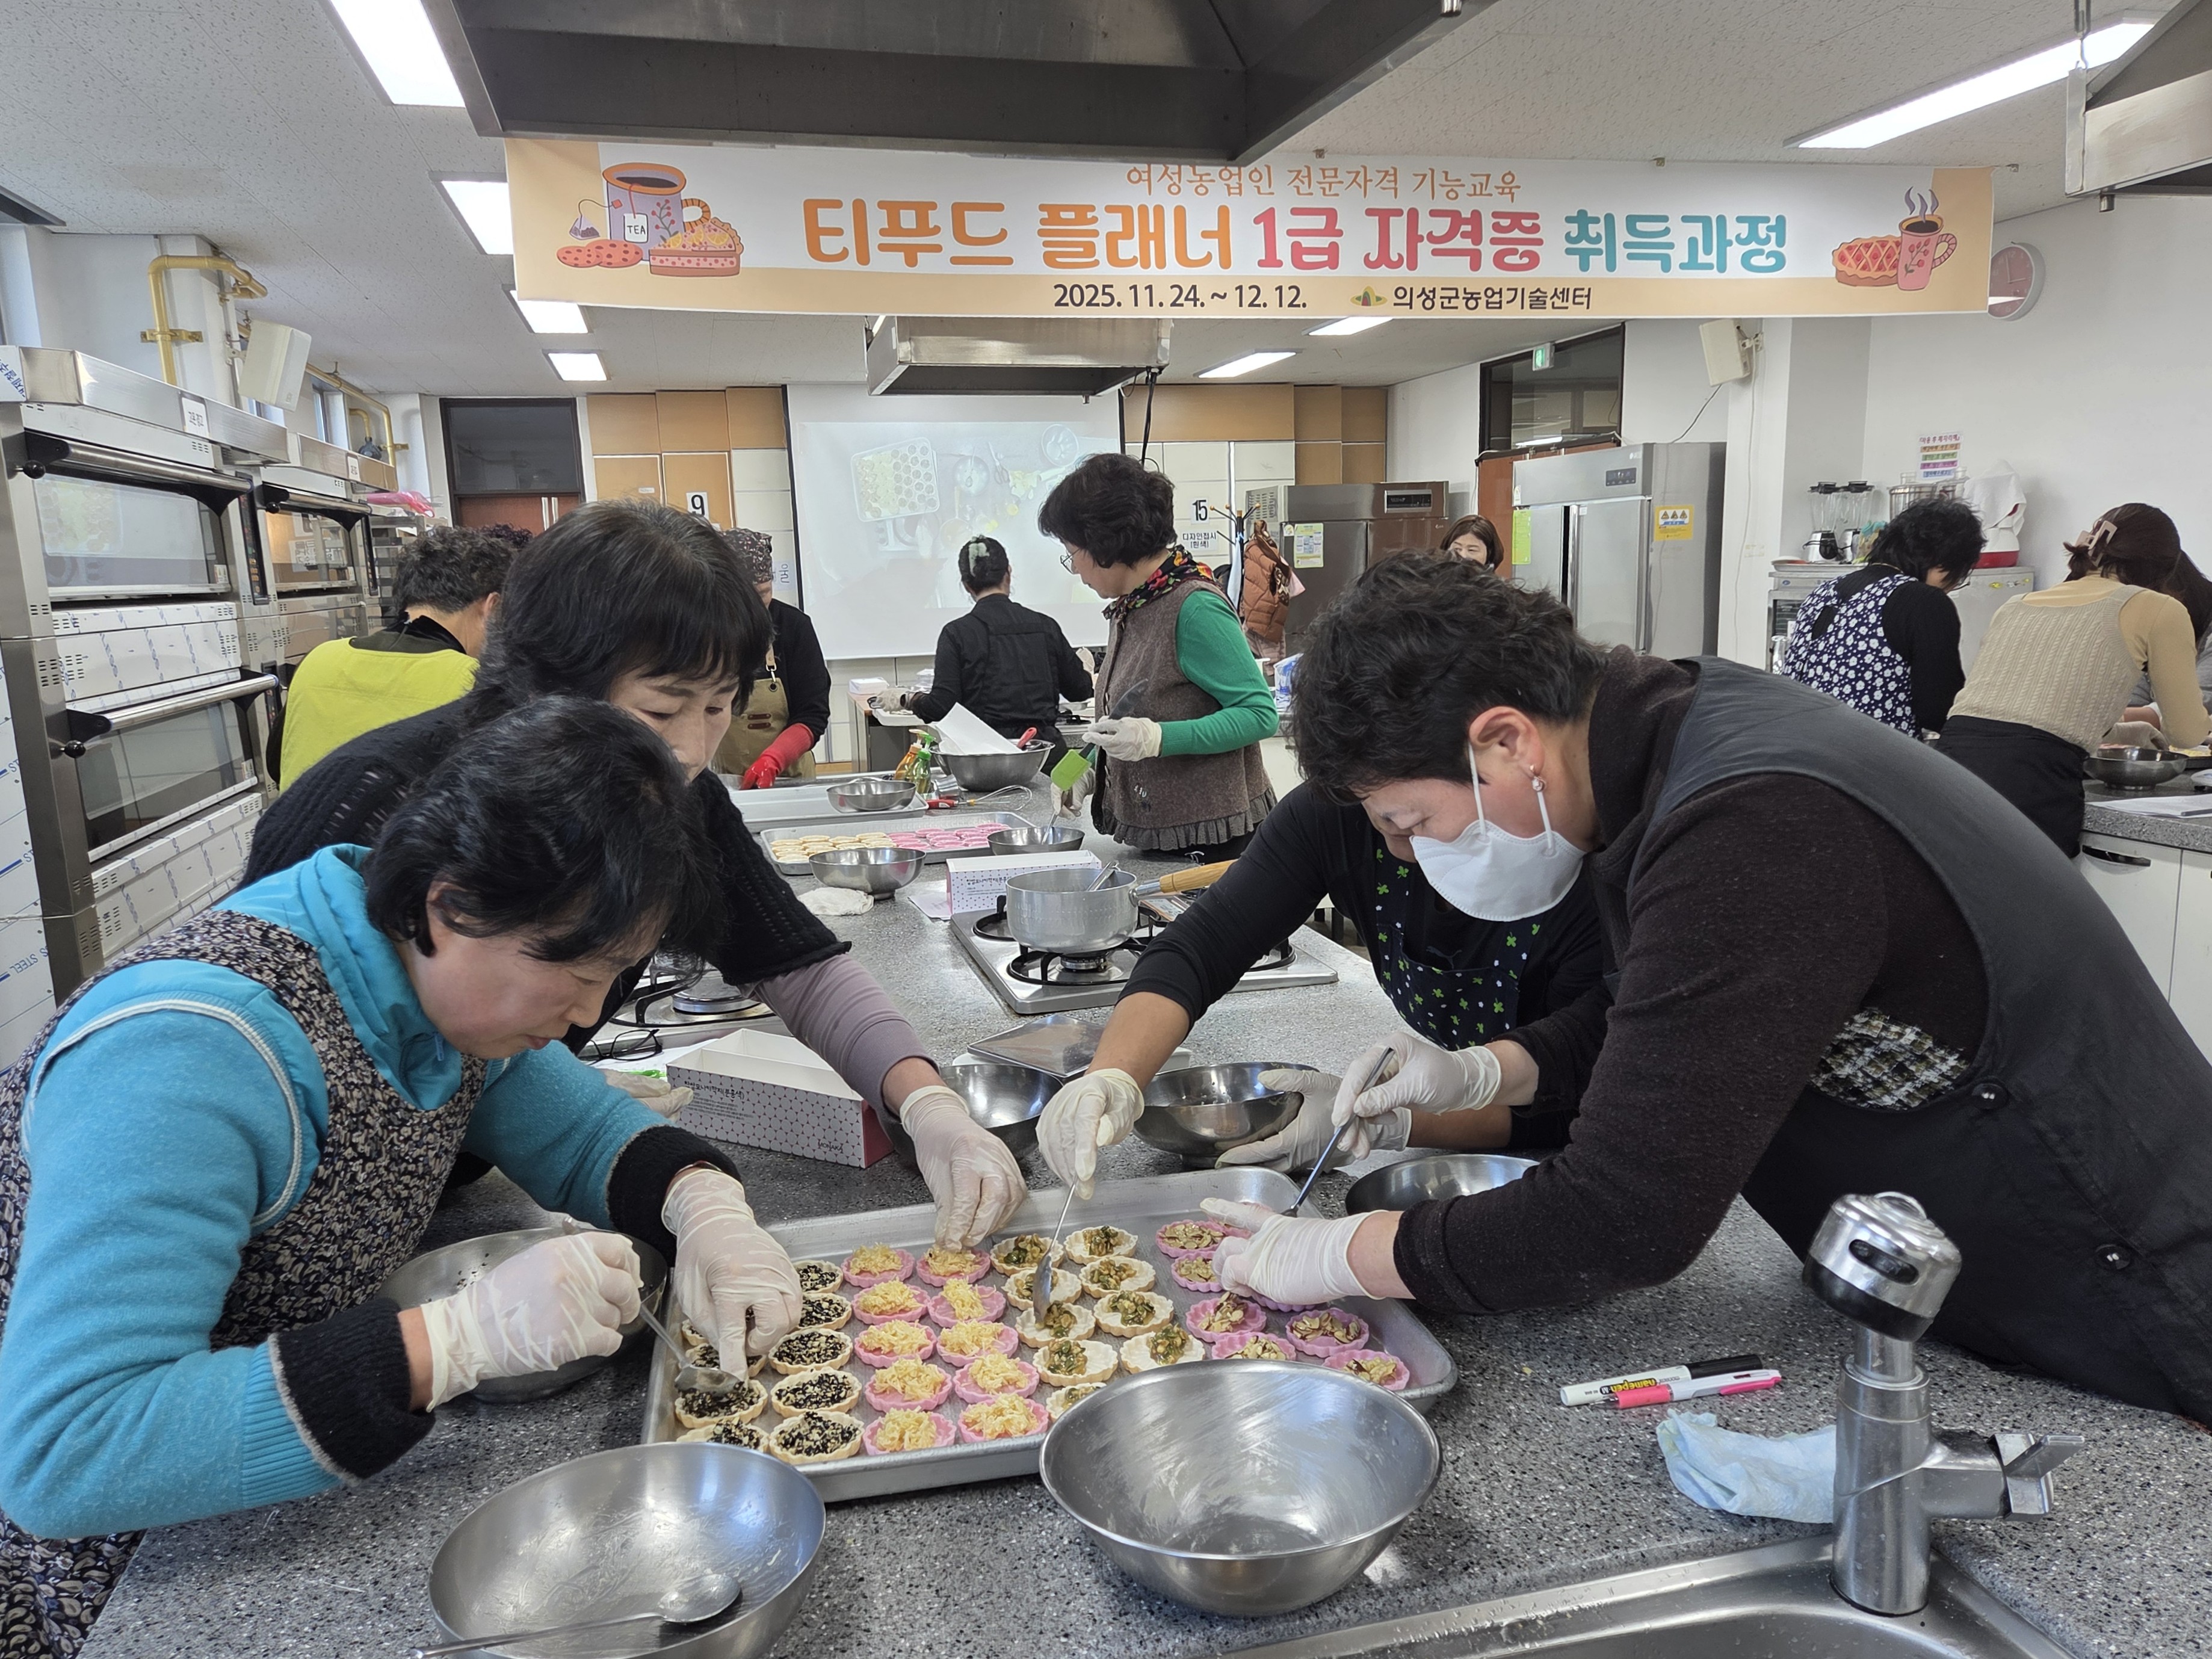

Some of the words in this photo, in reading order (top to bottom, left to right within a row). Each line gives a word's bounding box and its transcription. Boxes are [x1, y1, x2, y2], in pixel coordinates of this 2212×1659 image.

[1126, 164, 1274, 197] 여성농업인
[1287, 164, 1400, 200] 전문자격
[1412, 167, 1522, 203] 기능교육
[626, 225, 646, 235] TEA
[803, 198, 1015, 268] 티푸드
[1037, 203, 1232, 270] 플래너
[1253, 206, 1344, 270] 1급
[1363, 207, 1544, 272] 자격증
[1565, 209, 1787, 273] 취득과정
[1392, 285, 1592, 311] 의성군농업기술센터
[691, 494, 705, 516] 9
[1192, 499, 1208, 521] 15
[1182, 532, 1216, 541] 디자인접시
[1191, 540, 1209, 549] (흰색)
[10, 954, 39, 974] STEEL
